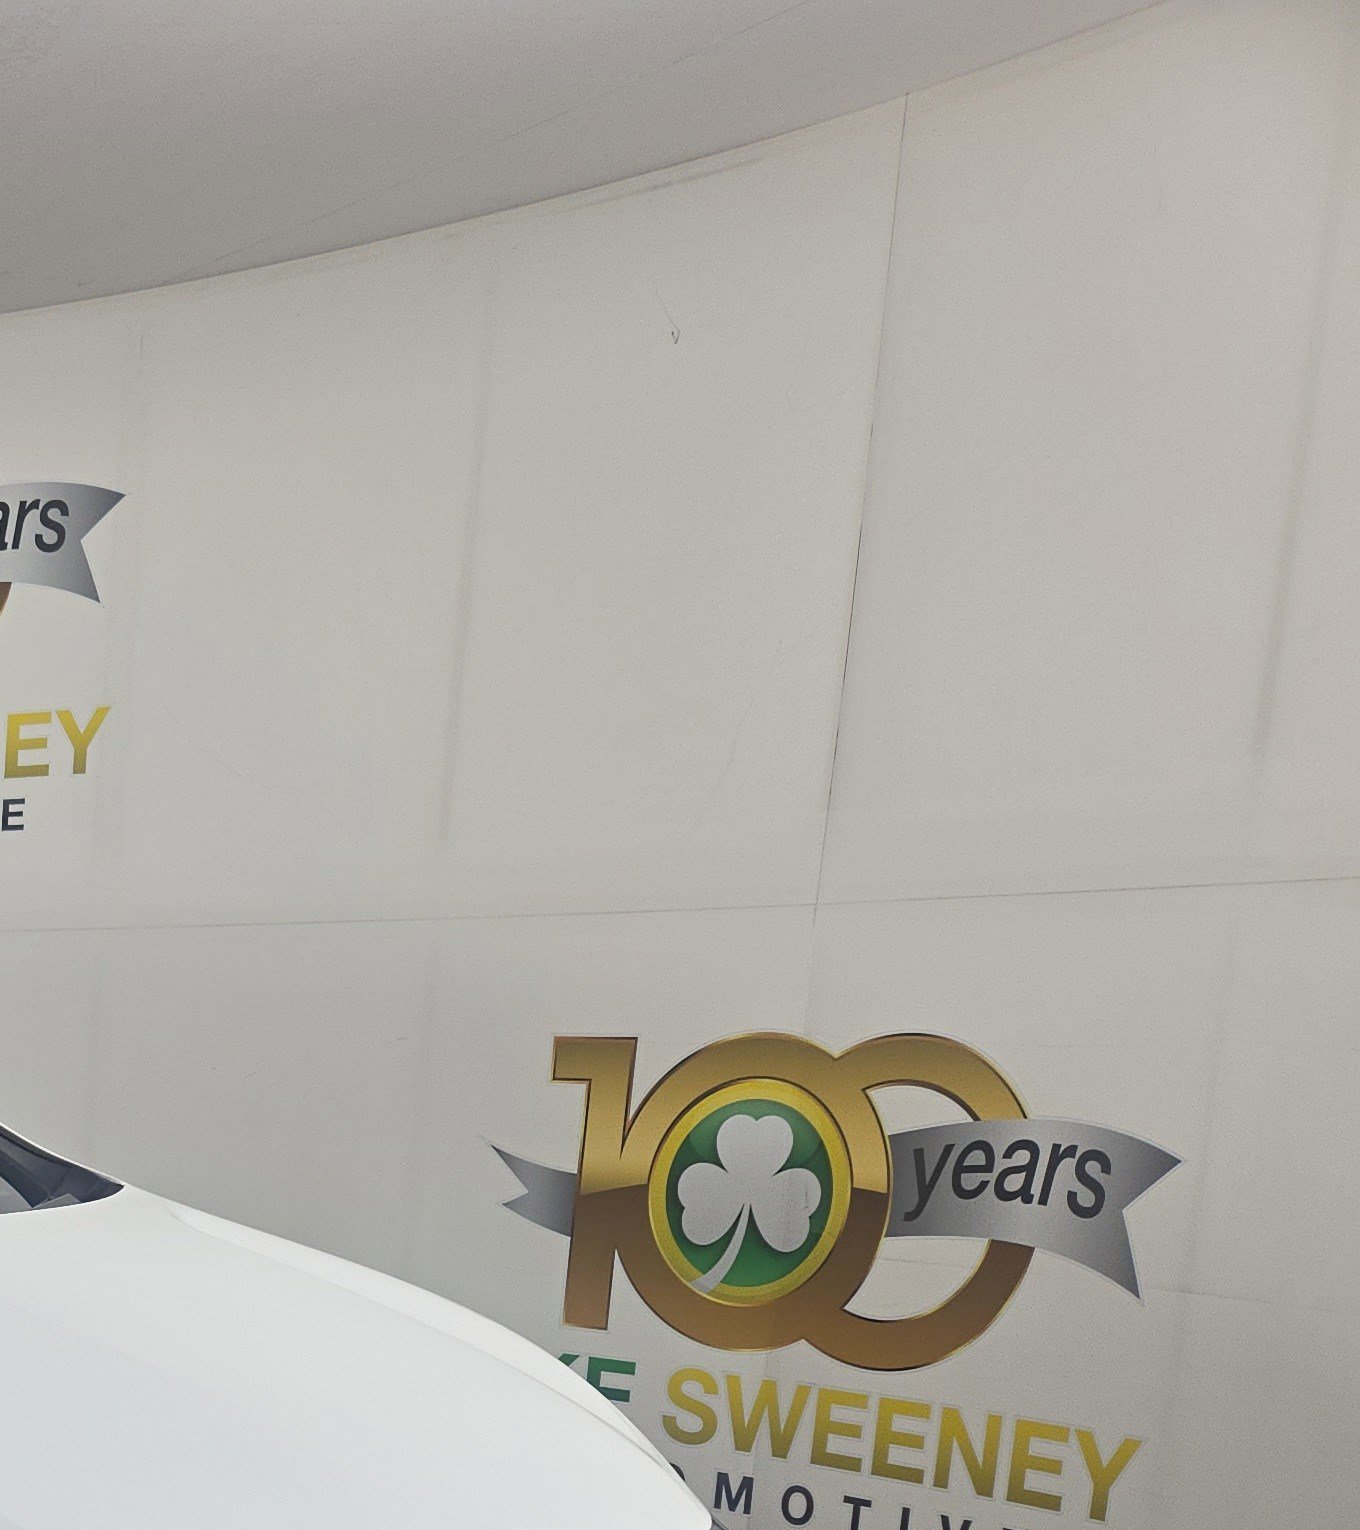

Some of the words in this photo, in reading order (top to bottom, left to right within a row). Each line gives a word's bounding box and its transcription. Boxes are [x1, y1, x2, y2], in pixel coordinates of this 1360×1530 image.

[551, 1030, 1037, 1372] 100
[903, 1138, 1111, 1221] years
[661, 1366, 1143, 1524] SWEENEY
